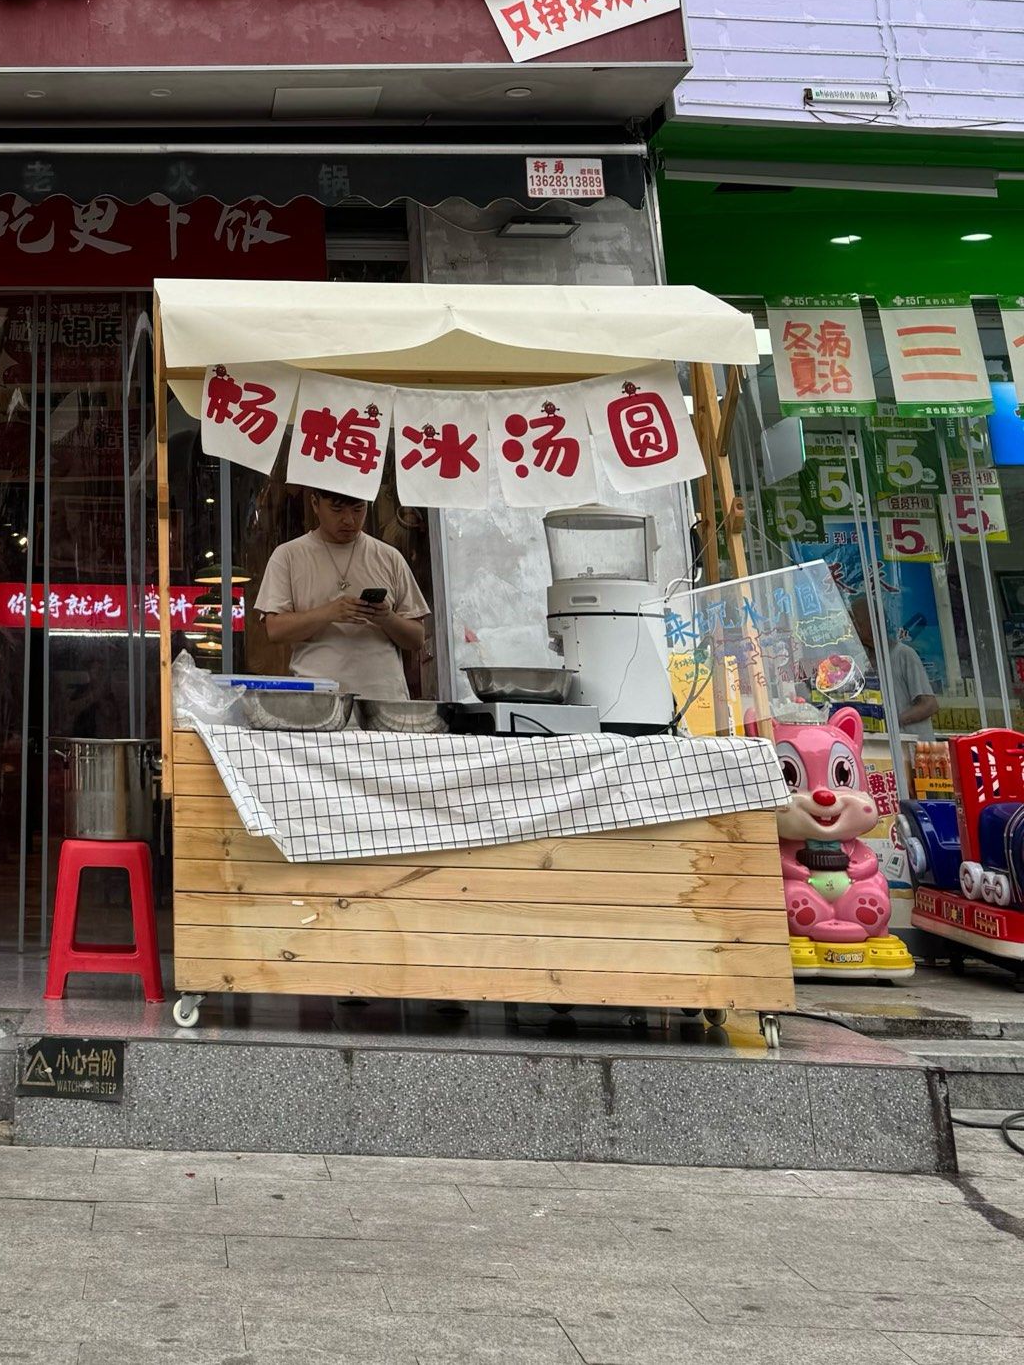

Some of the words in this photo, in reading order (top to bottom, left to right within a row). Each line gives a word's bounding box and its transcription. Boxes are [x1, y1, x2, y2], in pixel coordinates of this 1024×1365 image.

[529, 176, 602, 188] 13628313889
[892, 519, 925, 554] 5
[56, 1047, 116, 1077] 小心台阶
[57, 1080, 79, 1093] WATCH
[100, 1082, 116, 1095] STEP
